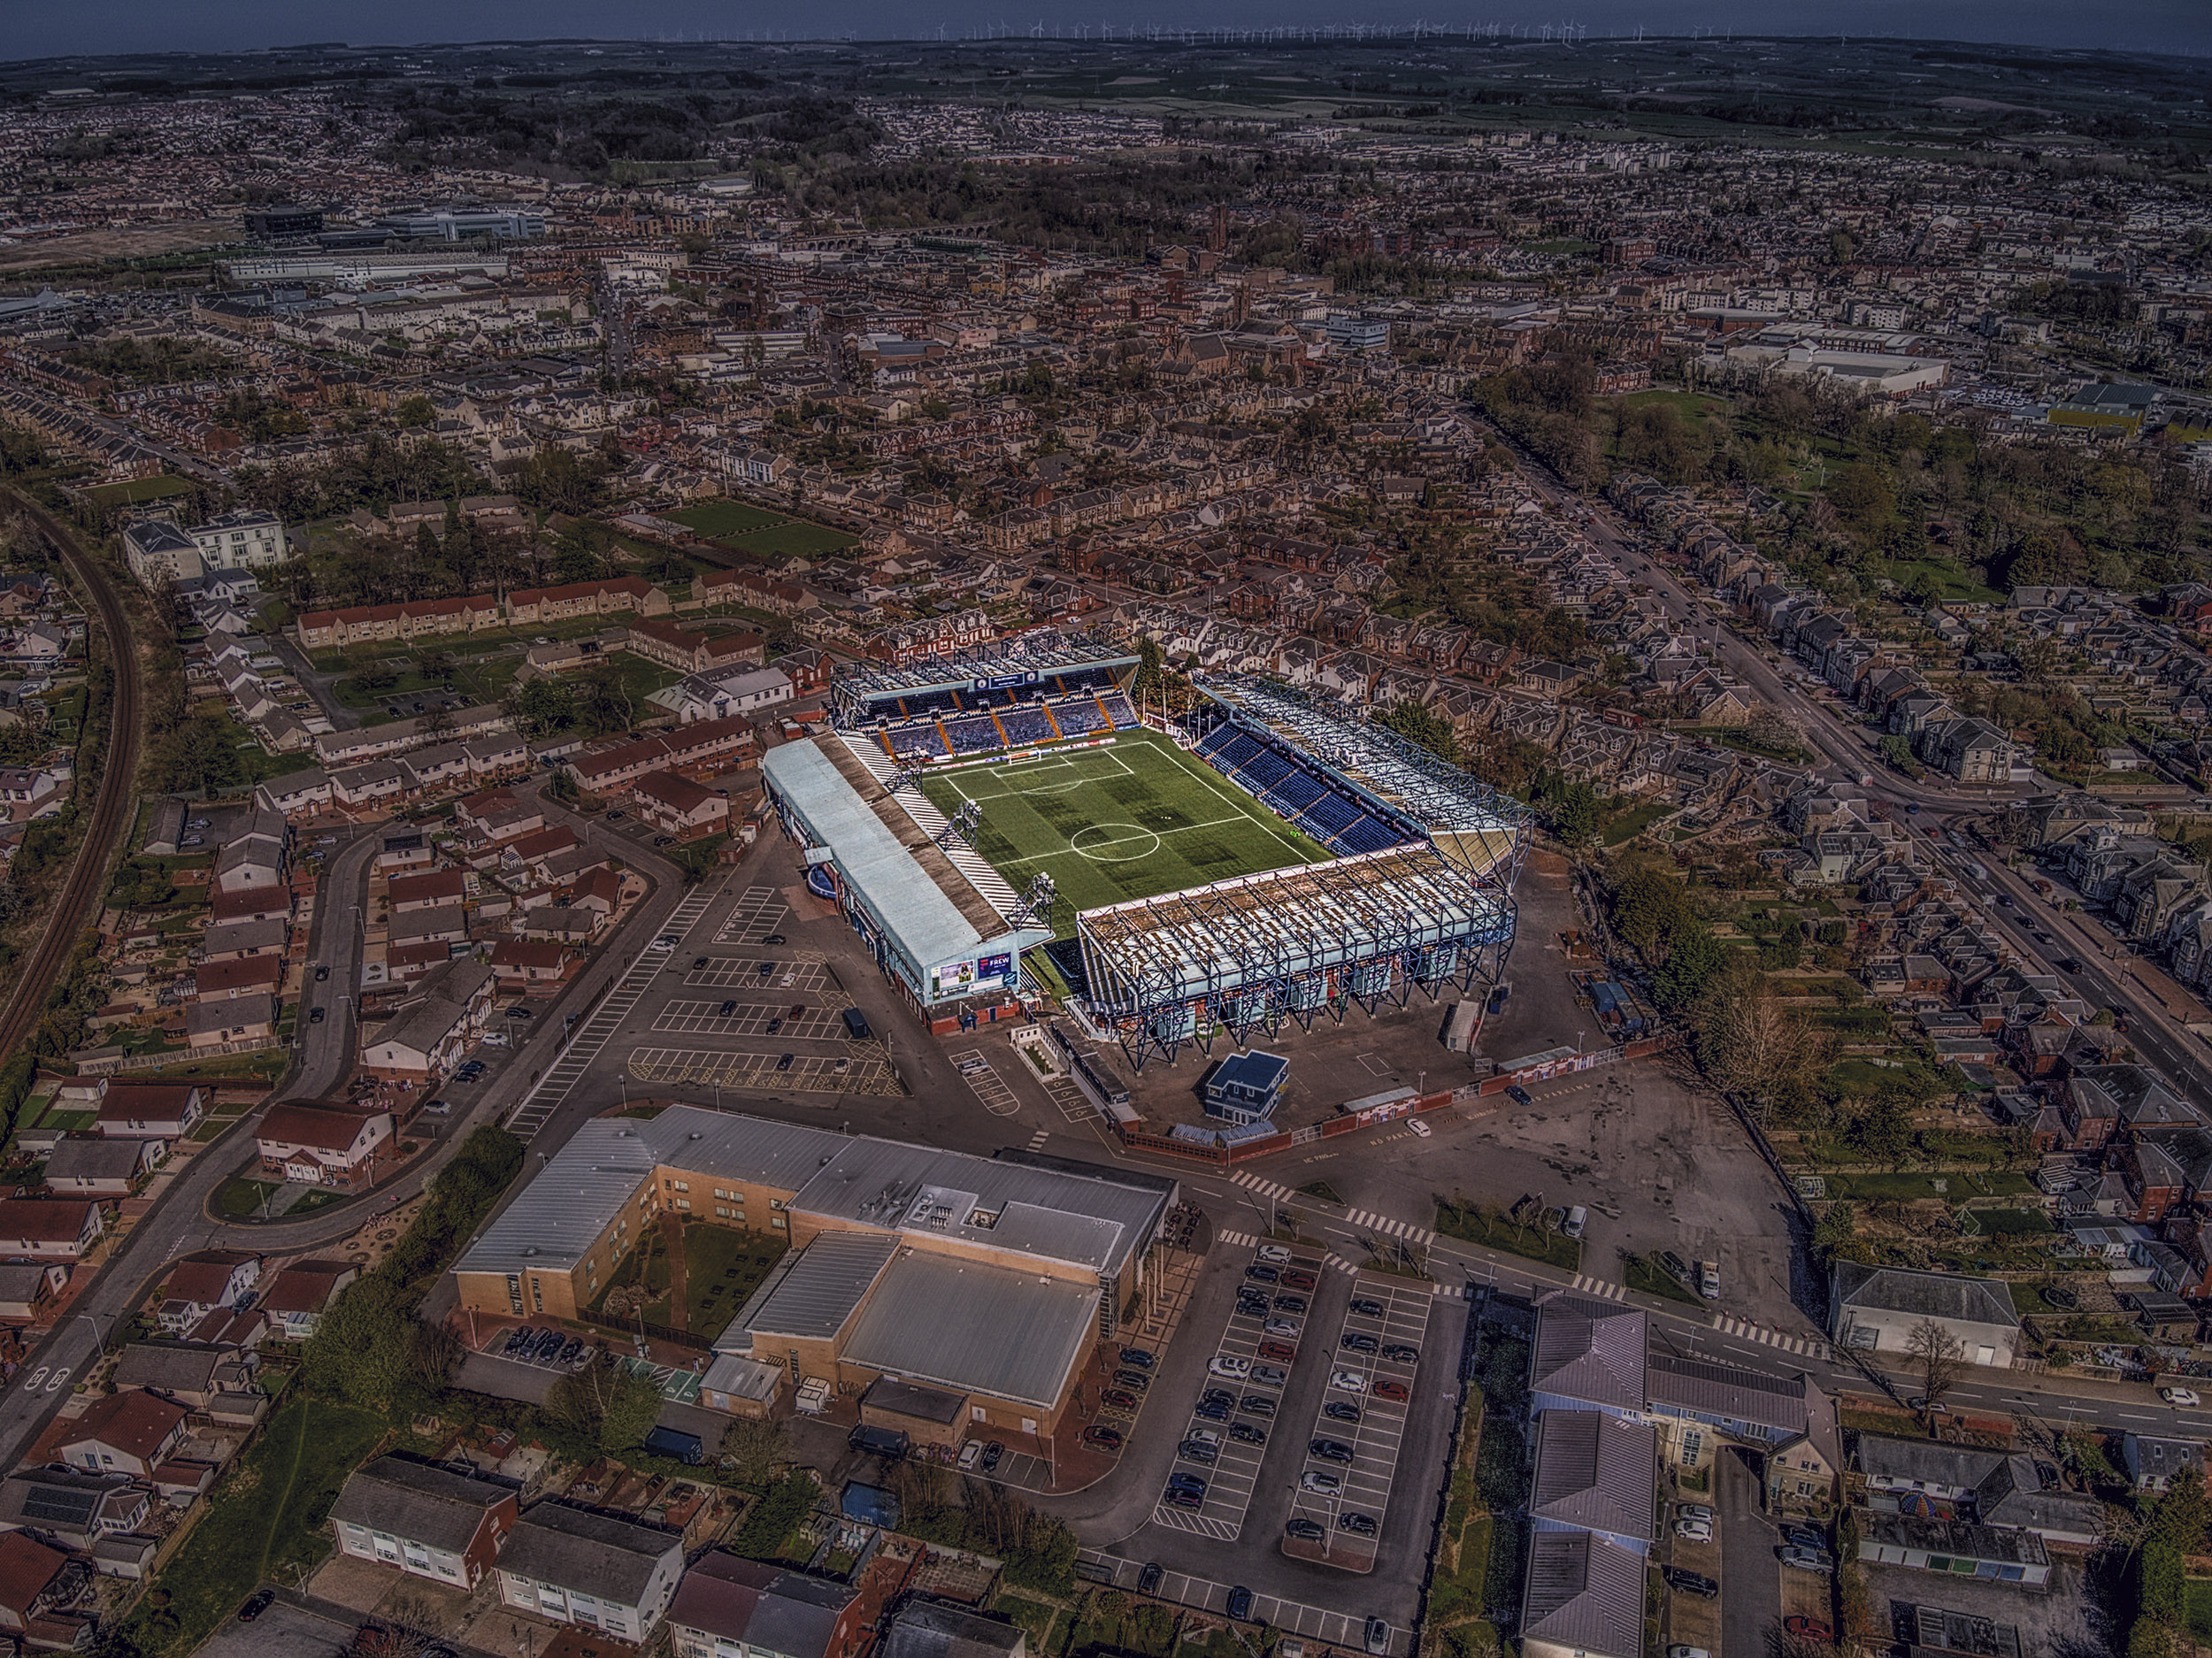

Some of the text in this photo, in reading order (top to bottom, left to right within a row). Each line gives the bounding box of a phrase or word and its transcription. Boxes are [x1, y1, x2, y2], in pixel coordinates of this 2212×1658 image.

[989, 956, 1010, 966] FREW
[1543, 1083, 1591, 1099] PARKING
[1370, 1138, 1384, 1147] NO
